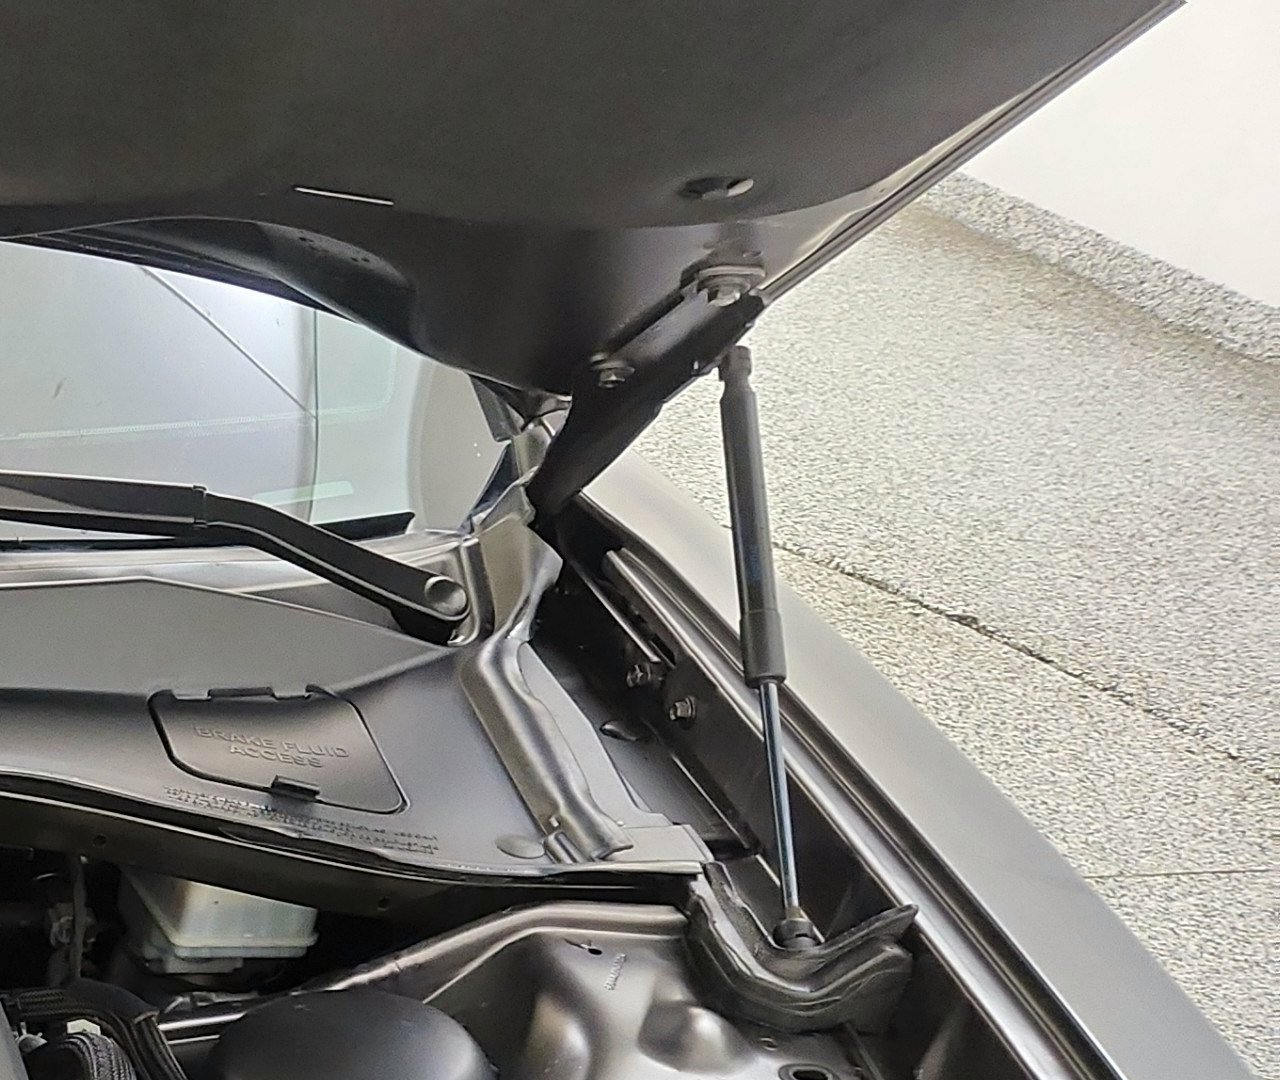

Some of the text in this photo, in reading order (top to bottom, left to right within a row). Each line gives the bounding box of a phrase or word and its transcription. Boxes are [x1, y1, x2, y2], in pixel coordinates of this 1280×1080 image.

[194, 726, 349, 758] BRAKE FLUID
[229, 744, 324, 769] ACCESS
